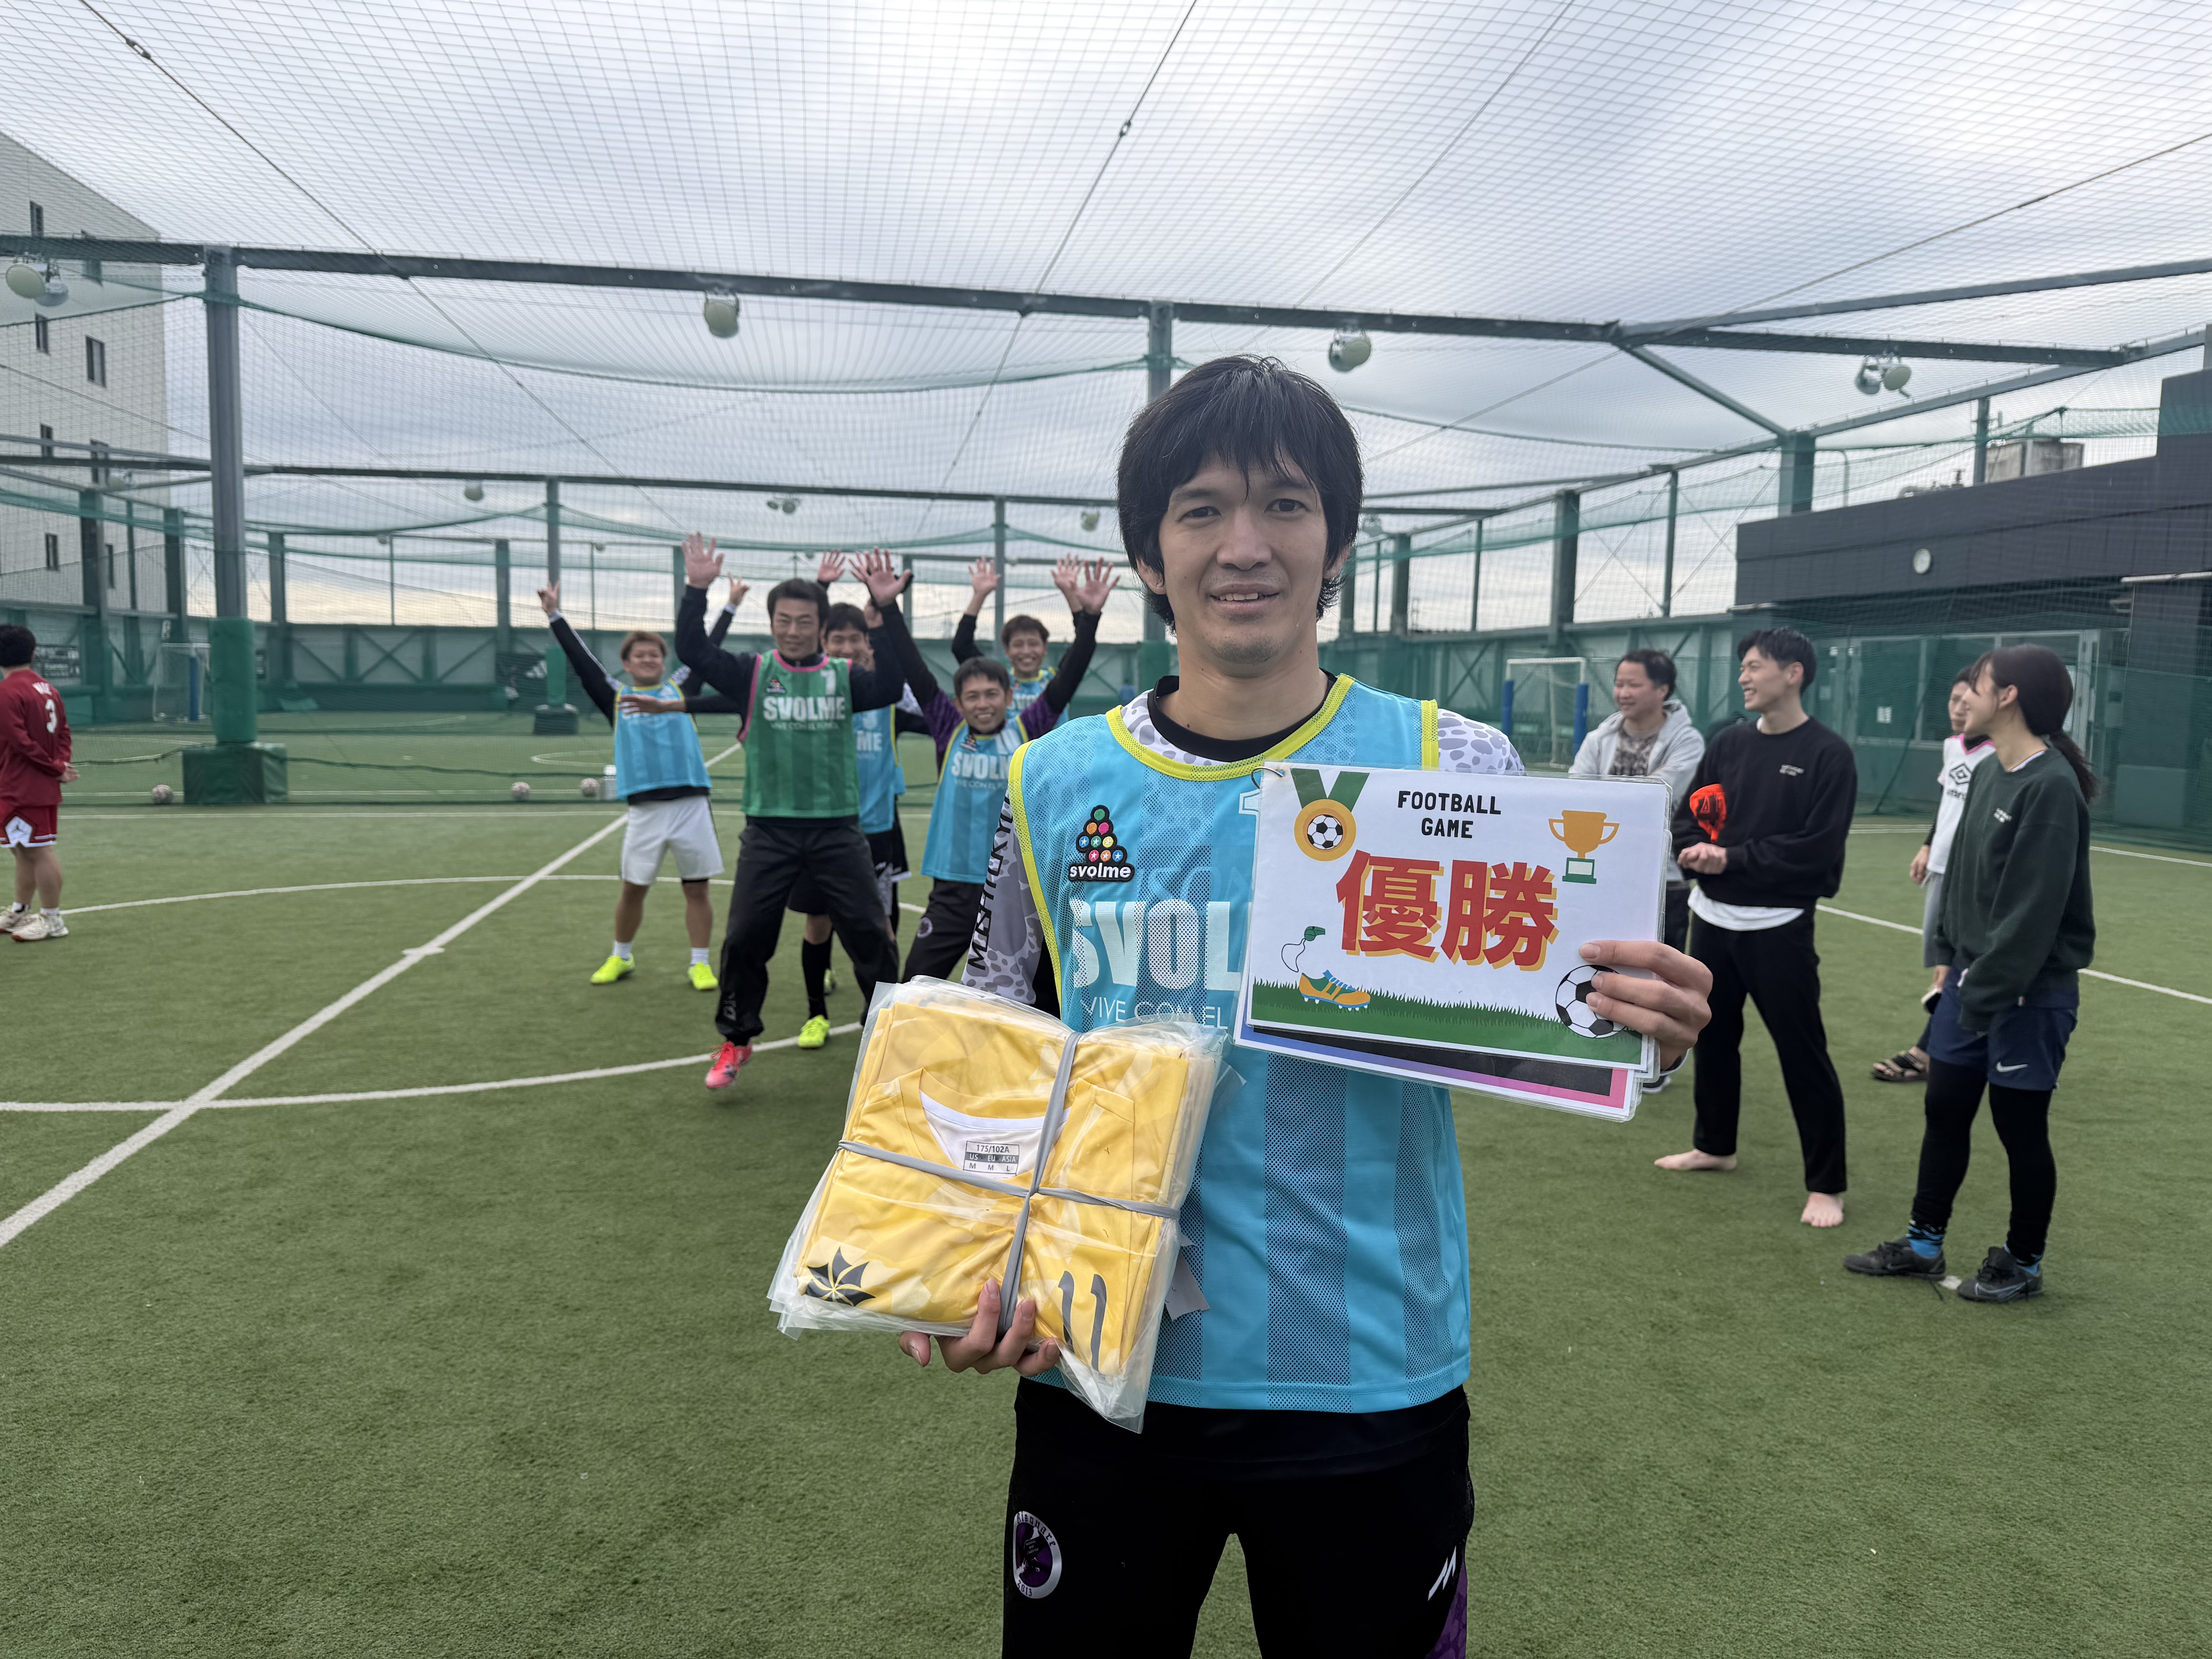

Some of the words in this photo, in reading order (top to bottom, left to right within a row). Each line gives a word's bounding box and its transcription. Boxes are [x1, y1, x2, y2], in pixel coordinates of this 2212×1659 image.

[45, 699, 57, 733] 3
[763, 697, 845, 721] SVOLME
[951, 751, 1009, 779] SVOL
[1398, 790, 1501, 814] FOOTBALL
[1421, 817, 1474, 838] GAME
[1070, 862, 1131, 878] svolme
[1336, 849, 1558, 971] 優勝
[1070, 899, 1243, 991] SVOL
[1080, 996, 1126, 1022] VIVE
[1203, 1006, 1228, 1029] EL
[976, 1144, 1010, 1153] 175/102A
[1017, 1580, 1032, 1597] 2013
